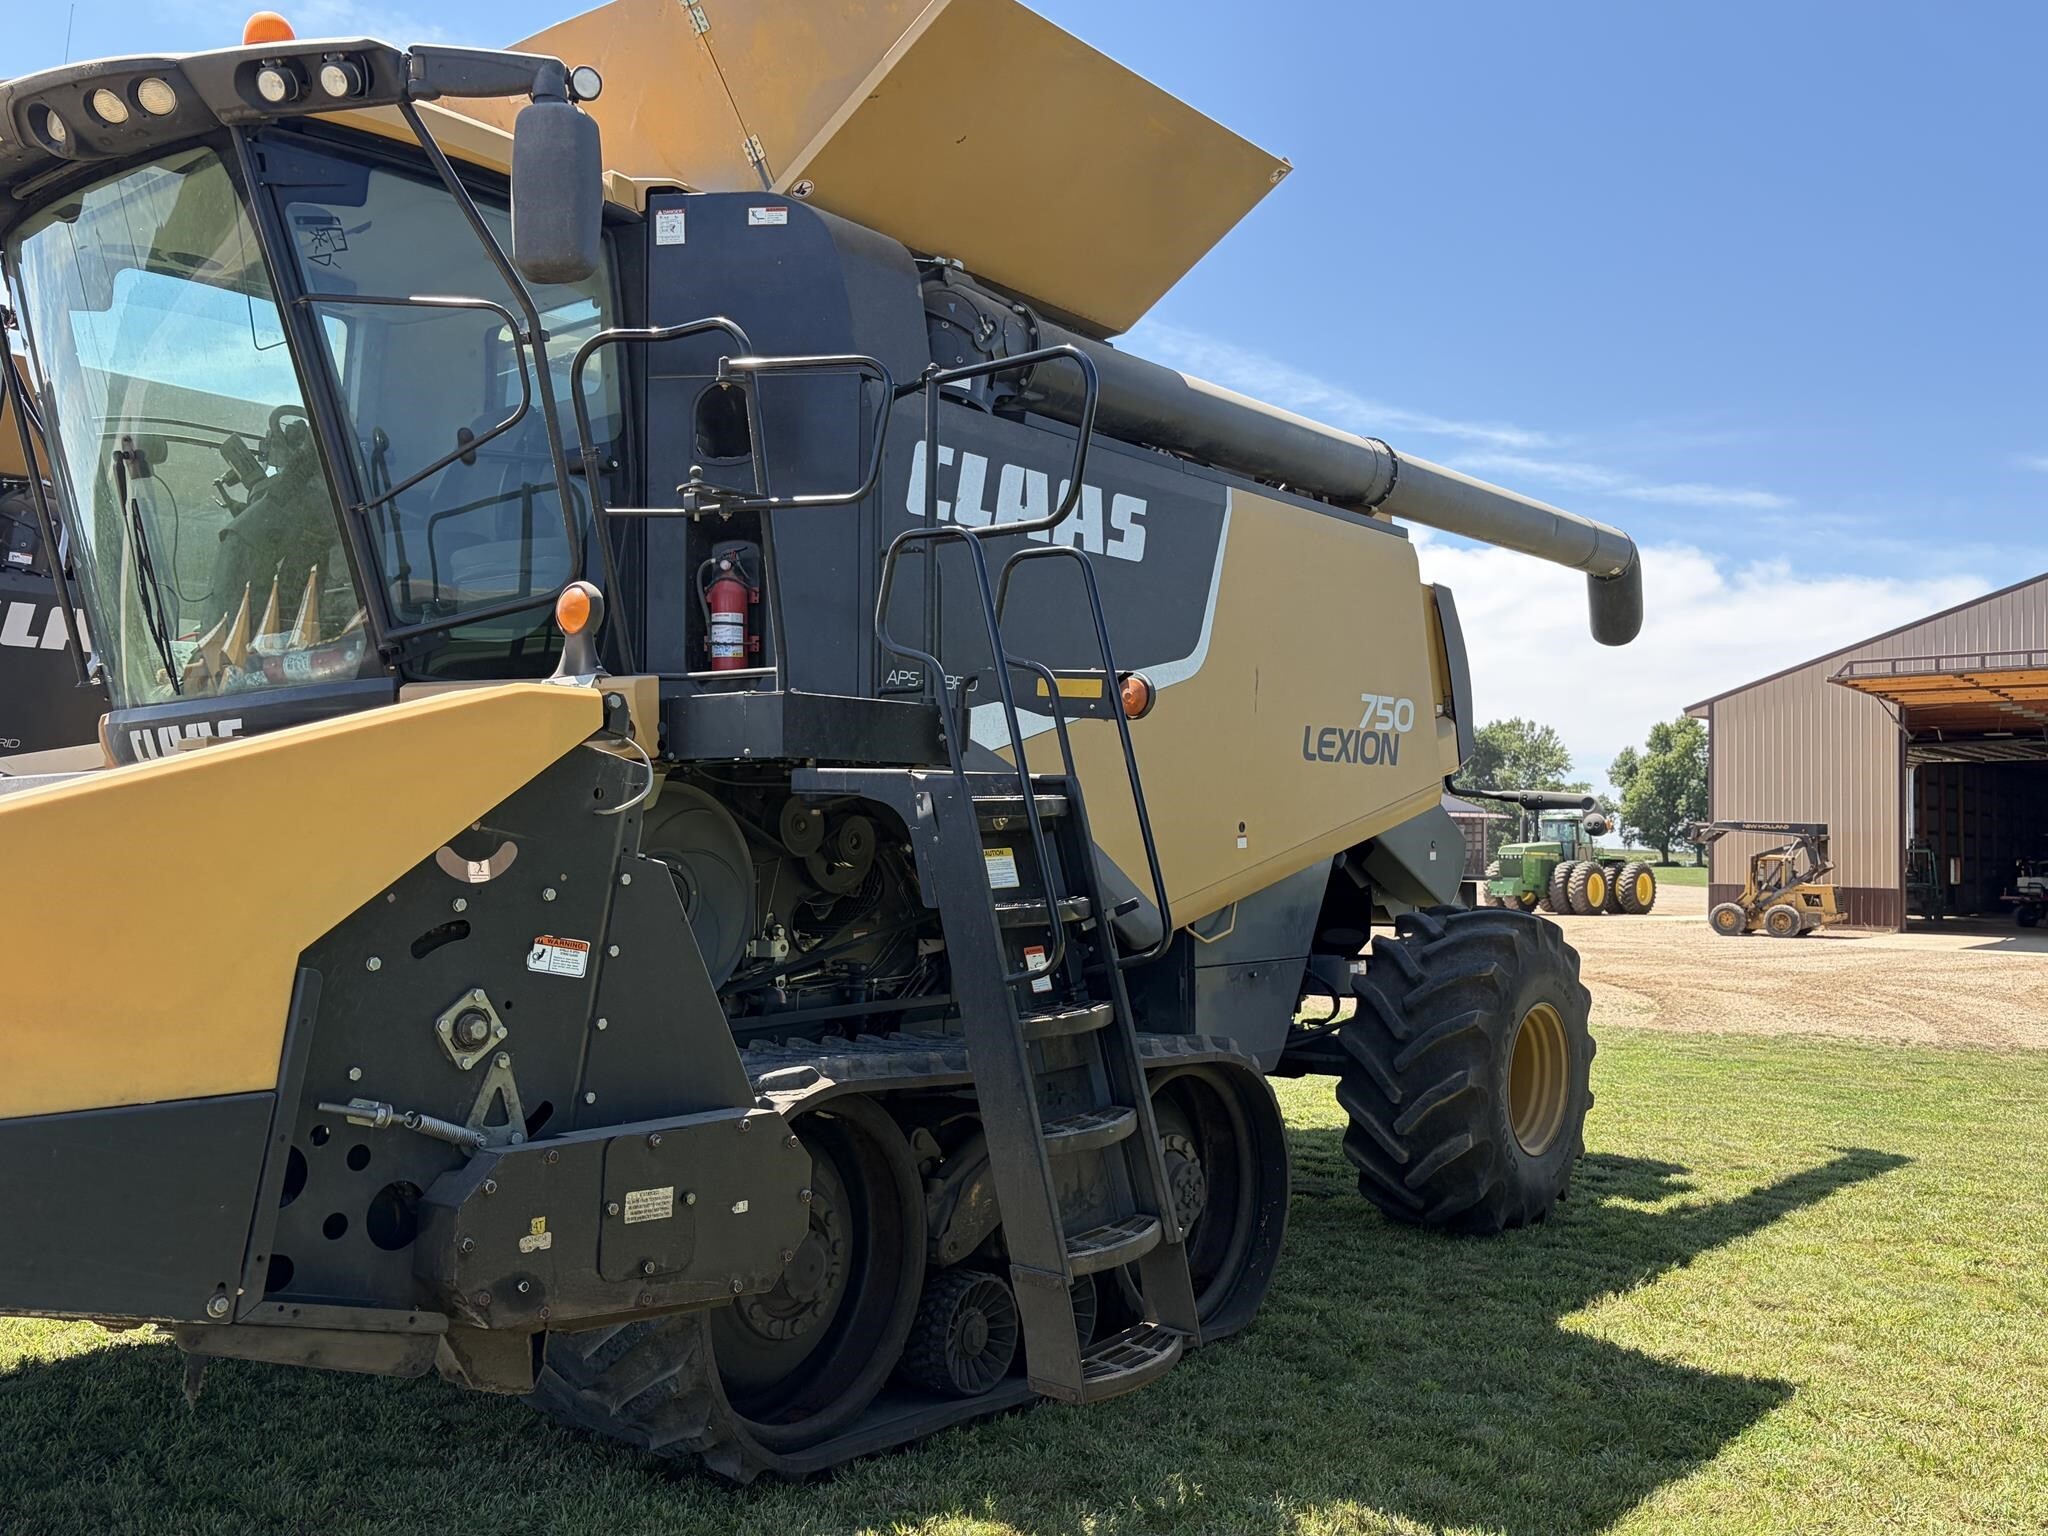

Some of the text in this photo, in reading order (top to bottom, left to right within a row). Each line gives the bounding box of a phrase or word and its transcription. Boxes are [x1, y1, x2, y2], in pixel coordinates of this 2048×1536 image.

[906, 440, 1147, 562] CLAAS
[886, 669, 920, 687] APS
[1360, 693, 1415, 732] 750
[1302, 725, 1400, 766] LEXION
[547, 938, 583, 949] WARNING
